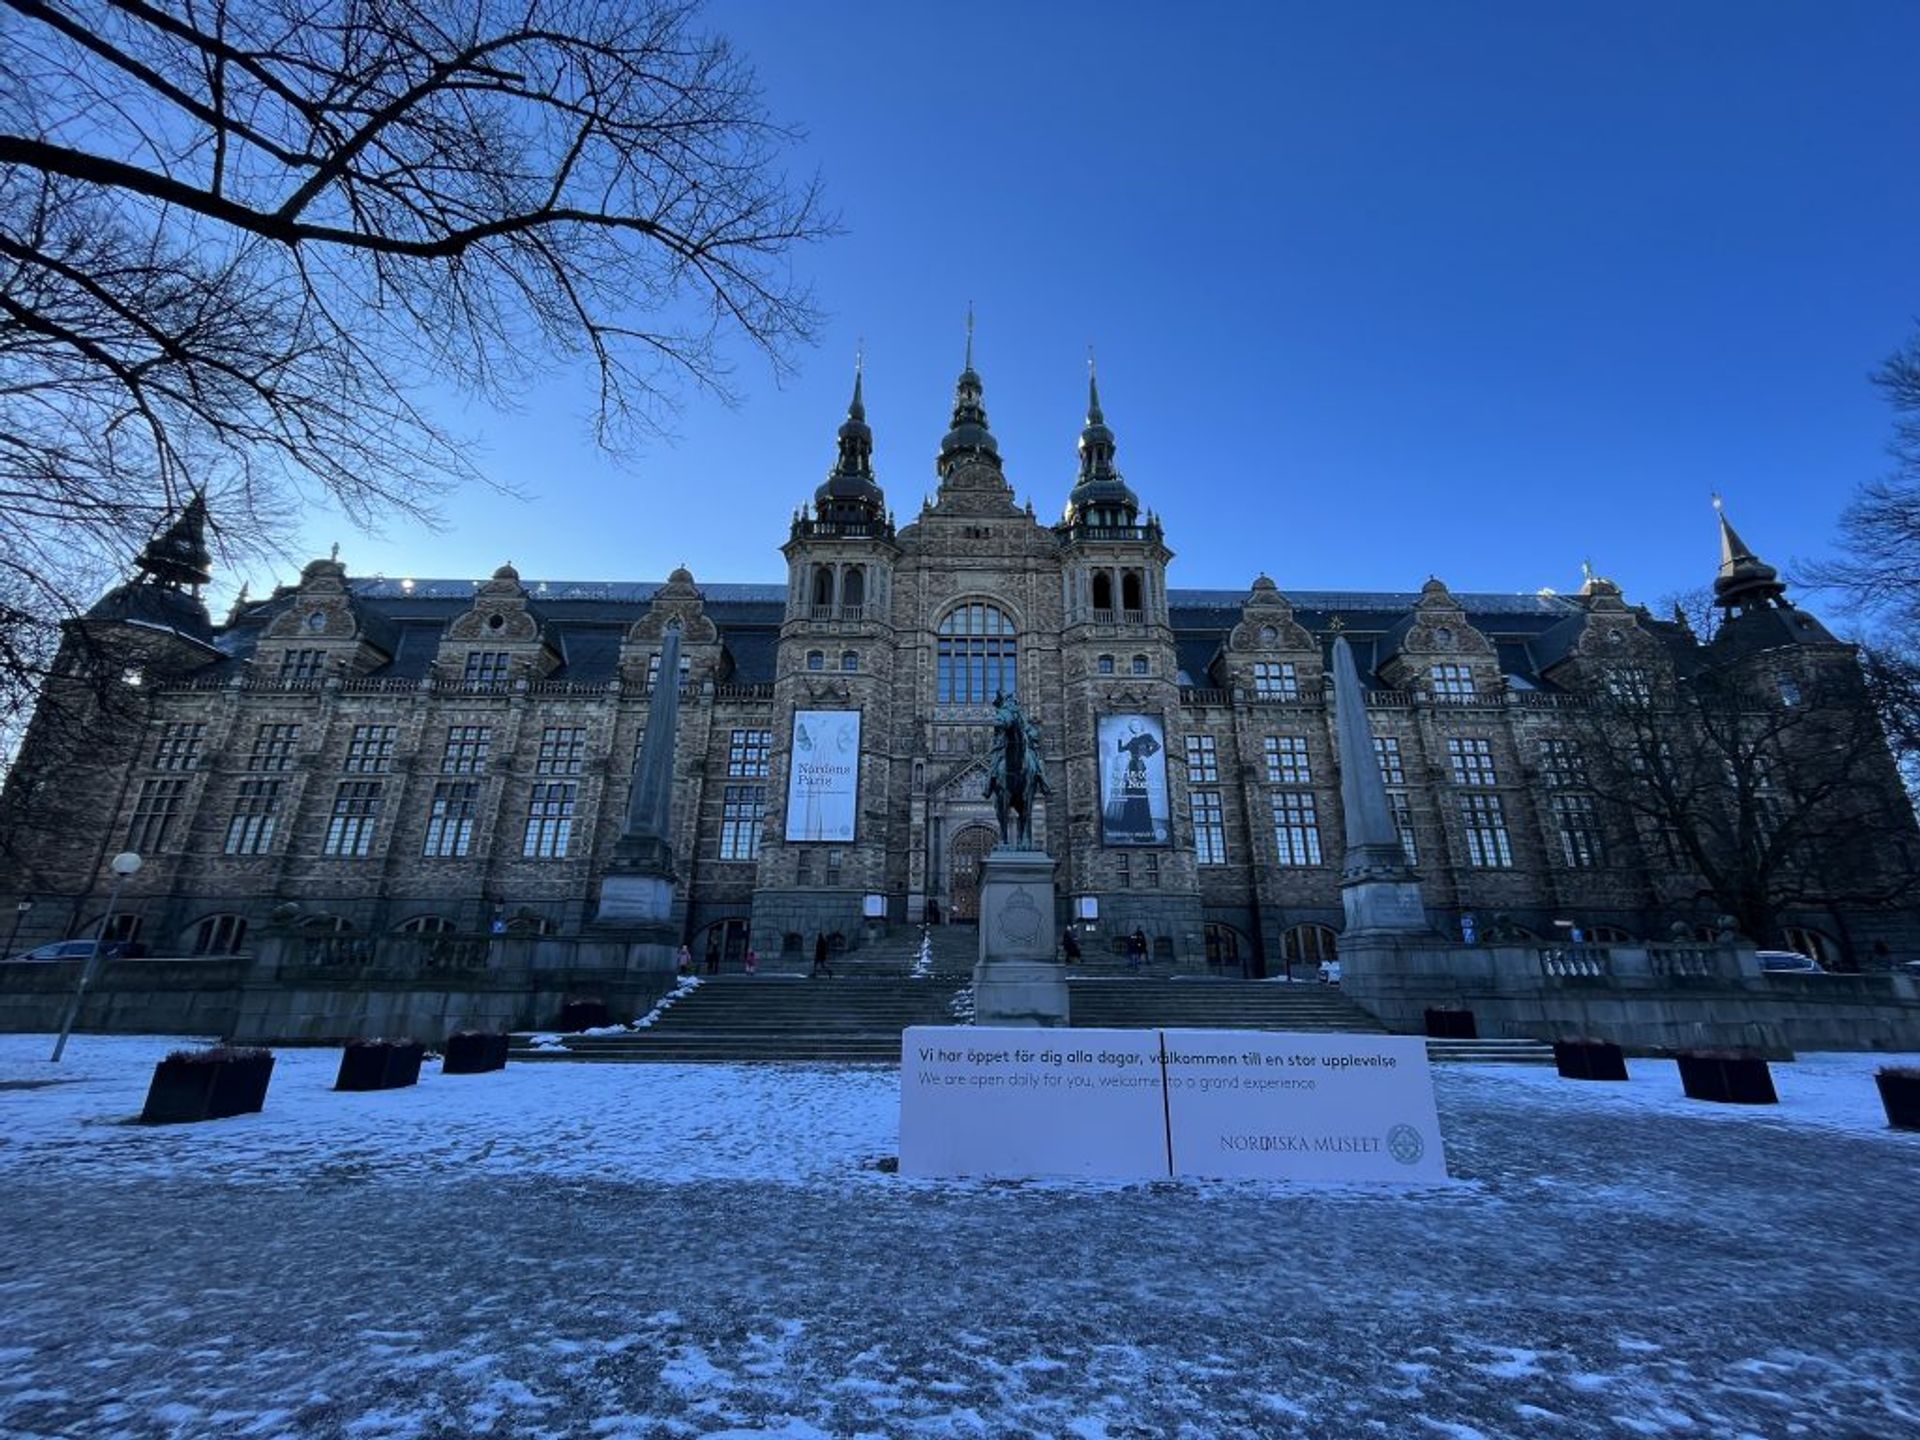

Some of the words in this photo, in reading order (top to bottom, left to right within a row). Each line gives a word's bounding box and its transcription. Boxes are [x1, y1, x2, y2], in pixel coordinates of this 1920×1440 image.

[919, 1047, 934, 1062] Vi
[938, 1048, 962, 1063] har
[967, 1048, 1009, 1066] öppet
[1014, 1048, 1036, 1063] för
[1040, 1048, 1062, 1067] dig
[1067, 1048, 1093, 1064] alla
[1097, 1049, 1144, 1068] dagar,
[1242, 1051, 1262, 1067] till
[1265, 1055, 1284, 1067] en
[1288, 1053, 1317, 1067] stor
[1321, 1054, 1397, 1071] upplevelse
[919, 1072, 940, 1087] We
[943, 1075, 967, 1087] are
[970, 1075, 1005, 1089] open
[1008, 1073, 1040, 1089] daily
[1044, 1073, 1063, 1087] for
[1067, 1075, 1095, 1089] you,
[1099, 1074, 1161, 1089] welcome
[1167, 1075, 1183, 1088] to
[1186, 1077, 1196, 1088] a
[1200, 1074, 1240, 1093] grand
[1243, 1077, 1317, 1093] experience
[1221, 1135, 1311, 1152] NORDISKA
[1314, 1136, 1381, 1153] MUSEET
